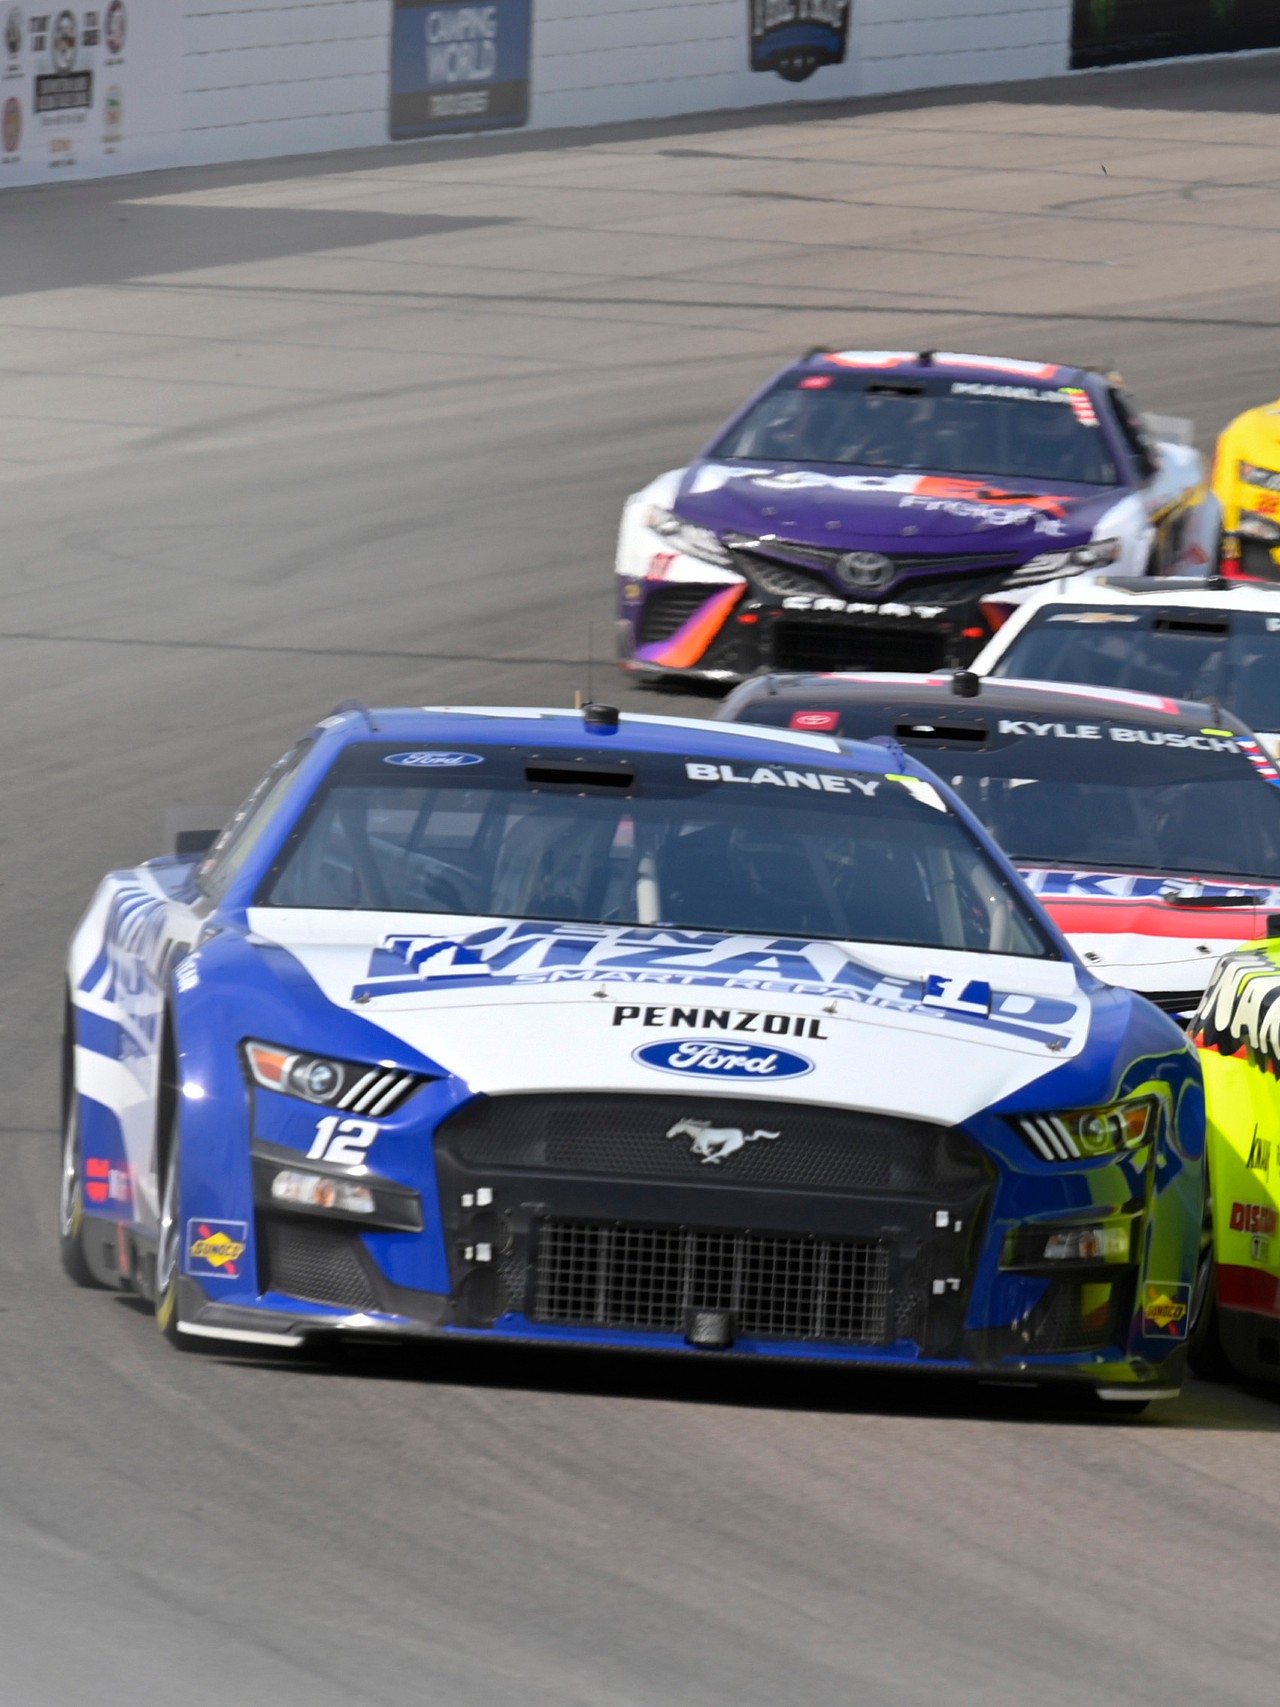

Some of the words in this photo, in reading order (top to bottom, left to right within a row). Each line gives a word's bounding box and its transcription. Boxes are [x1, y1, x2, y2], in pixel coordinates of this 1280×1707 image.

[999, 720, 1102, 739] KYLE
[1108, 727, 1240, 753] BUSCH
[402, 752, 464, 767] Ford
[686, 763, 879, 797] BLANEY
[514, 970, 708, 985] SMART
[723, 978, 947, 1018] REPAIRS
[612, 1006, 829, 1040] PENNZOIL
[667, 1040, 780, 1075] Ford
[306, 1116, 381, 1165] 12
[191, 1239, 243, 1259] SUNOCO
[1148, 1304, 1184, 1320] SUNOCO
